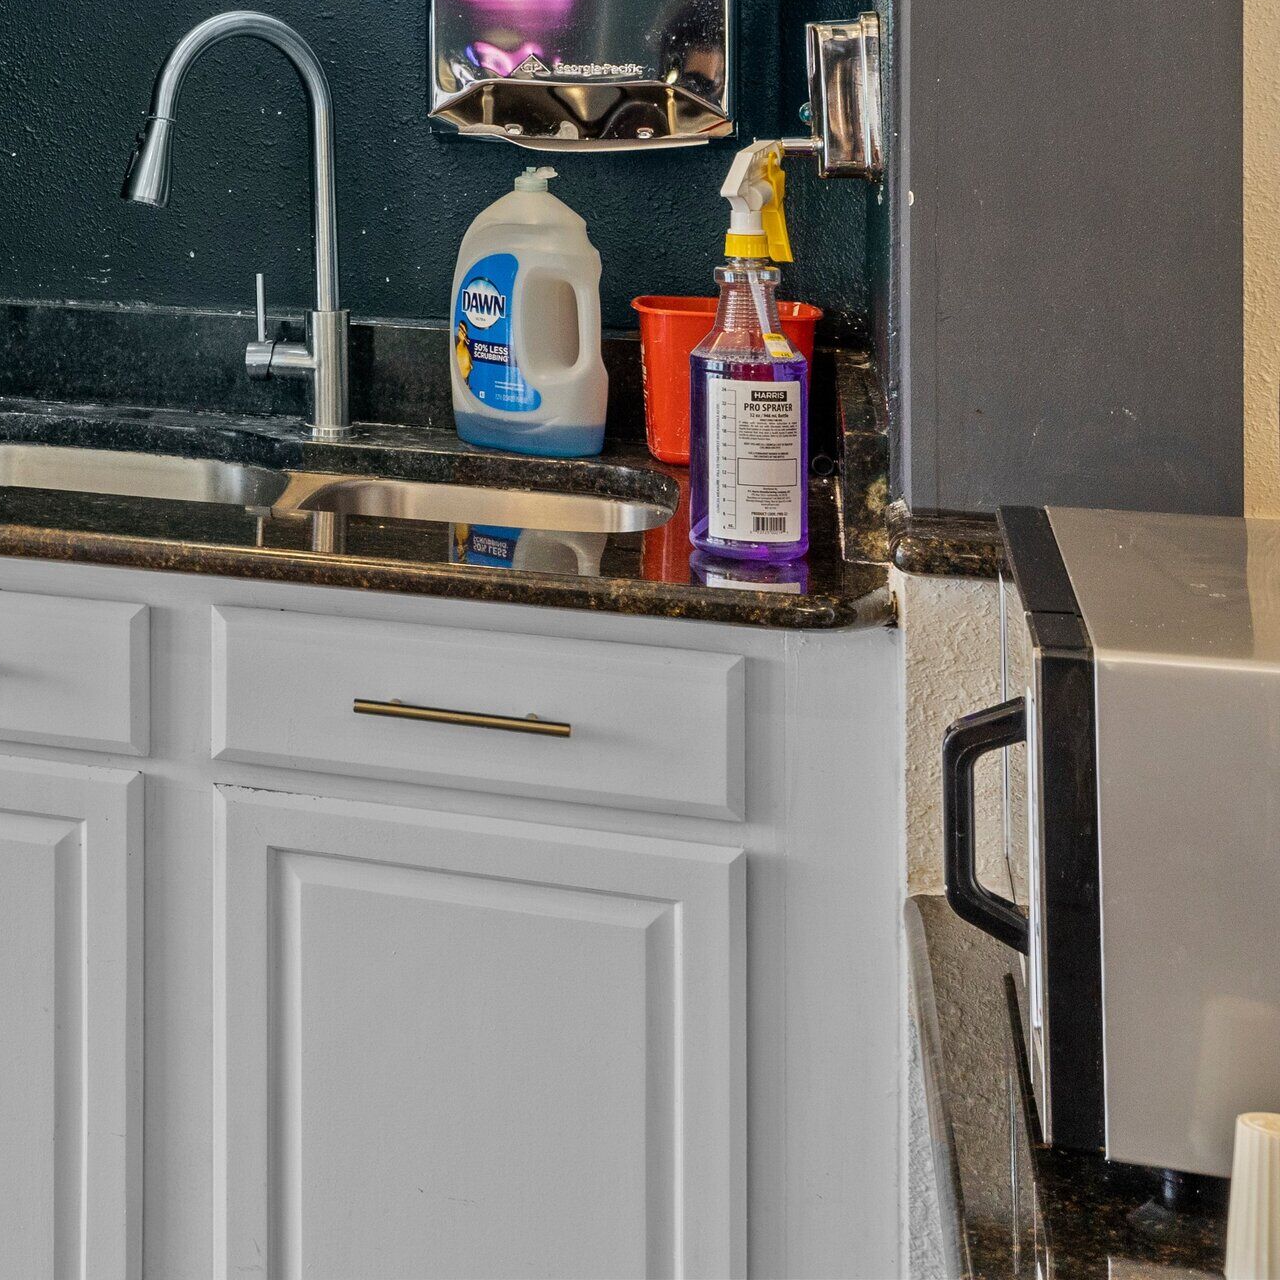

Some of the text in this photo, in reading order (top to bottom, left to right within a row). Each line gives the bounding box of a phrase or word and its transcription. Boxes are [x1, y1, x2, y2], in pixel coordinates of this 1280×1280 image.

[462, 290, 506, 318] DAWN
[474, 342, 509, 355] 50% LESS
[473, 350, 508, 362] SCRUBBING
[754, 391, 785, 399] HARRIS
[744, 403, 793, 412] PRO SPRAYER
